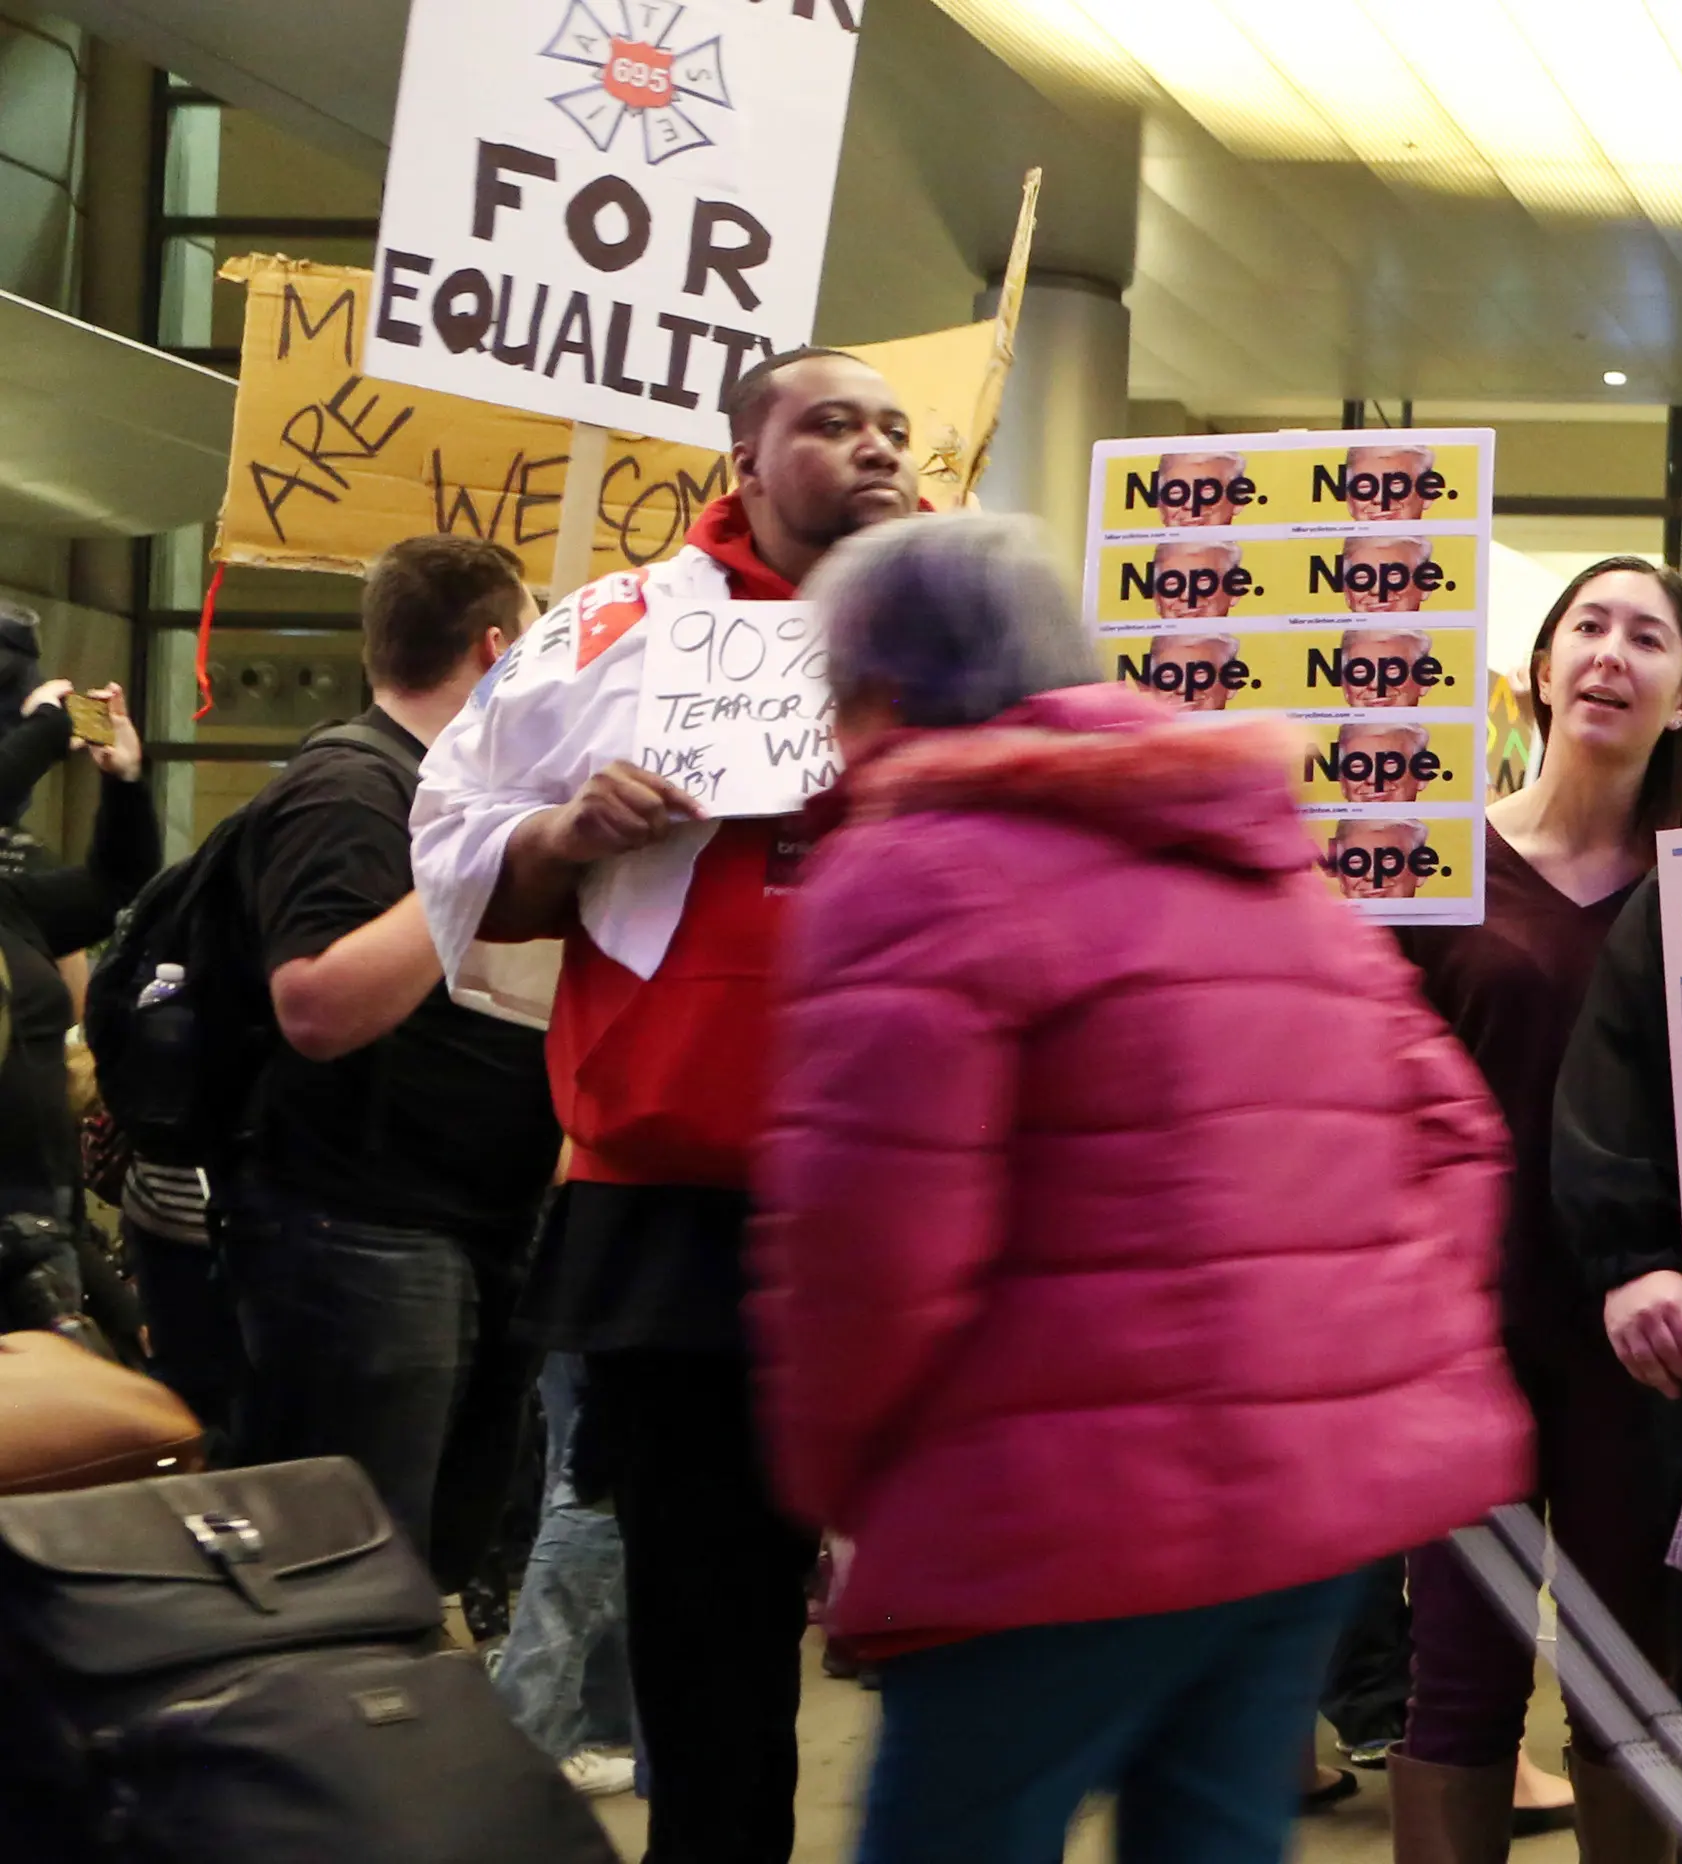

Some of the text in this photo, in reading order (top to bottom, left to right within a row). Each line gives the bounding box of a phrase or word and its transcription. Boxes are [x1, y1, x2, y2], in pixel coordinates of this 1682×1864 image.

[612, 57, 670, 93] 695
[471, 137, 773, 311] FOR
[249, 375, 414, 543] ARE
[431, 448, 729, 566] WECOM
[1125, 462, 1459, 519] Nope. Nope.
[1120, 553, 1457, 609] Nope. Nope.
[670, 610, 831, 684] 90%
[1116, 647, 1456, 701] Nope. Nope.
[656, 692, 812, 734] TERROR
[1303, 742, 1454, 792] Nope.
